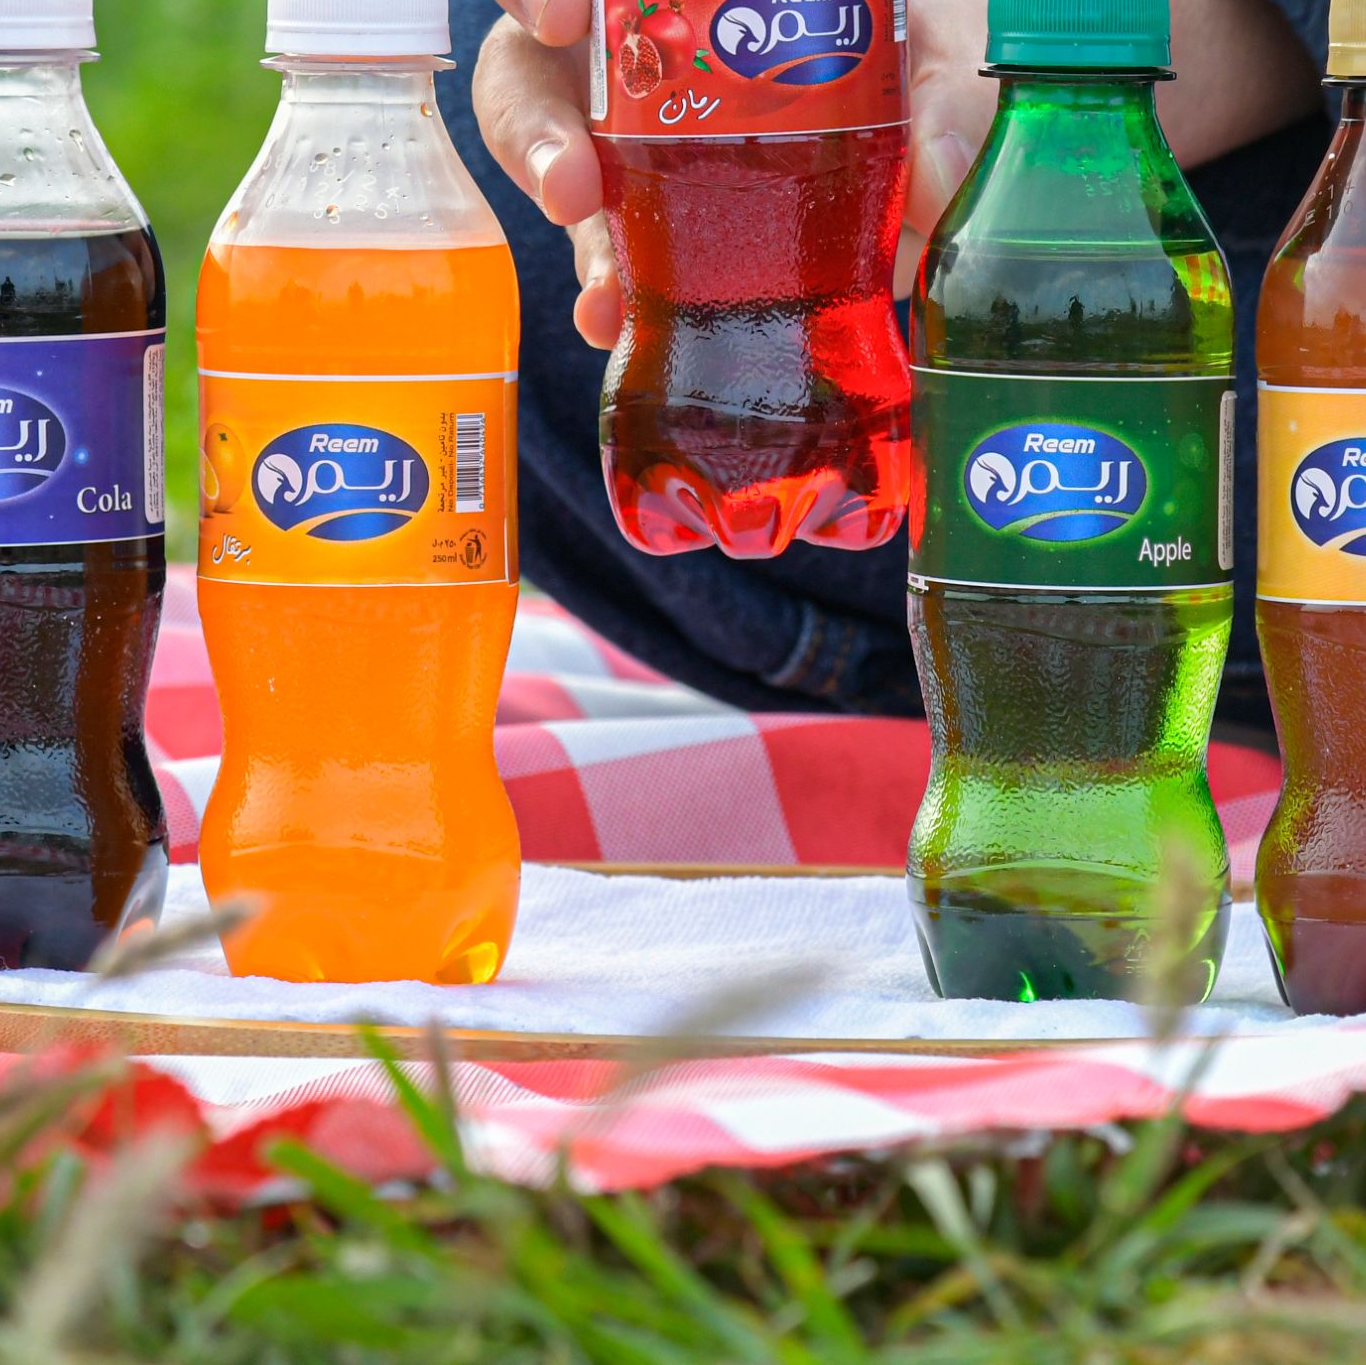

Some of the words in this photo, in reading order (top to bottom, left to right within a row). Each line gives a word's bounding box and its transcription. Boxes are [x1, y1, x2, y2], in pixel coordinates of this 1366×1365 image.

[759, 4, 862, 56] ريم
[658, 89, 721, 125] رمان
[309, 433, 379, 453] Reem
[1023, 433, 1095, 454] Reem
[294, 459, 415, 507] ريم
[1007, 459, 1133, 506] ريم
[77, 484, 133, 514] Cola
[212, 533, 252, 565] برتقال
[432, 555, 446, 563] 250
[447, 552, 458, 563] ml
[1138, 536, 1192, 567] Apple
